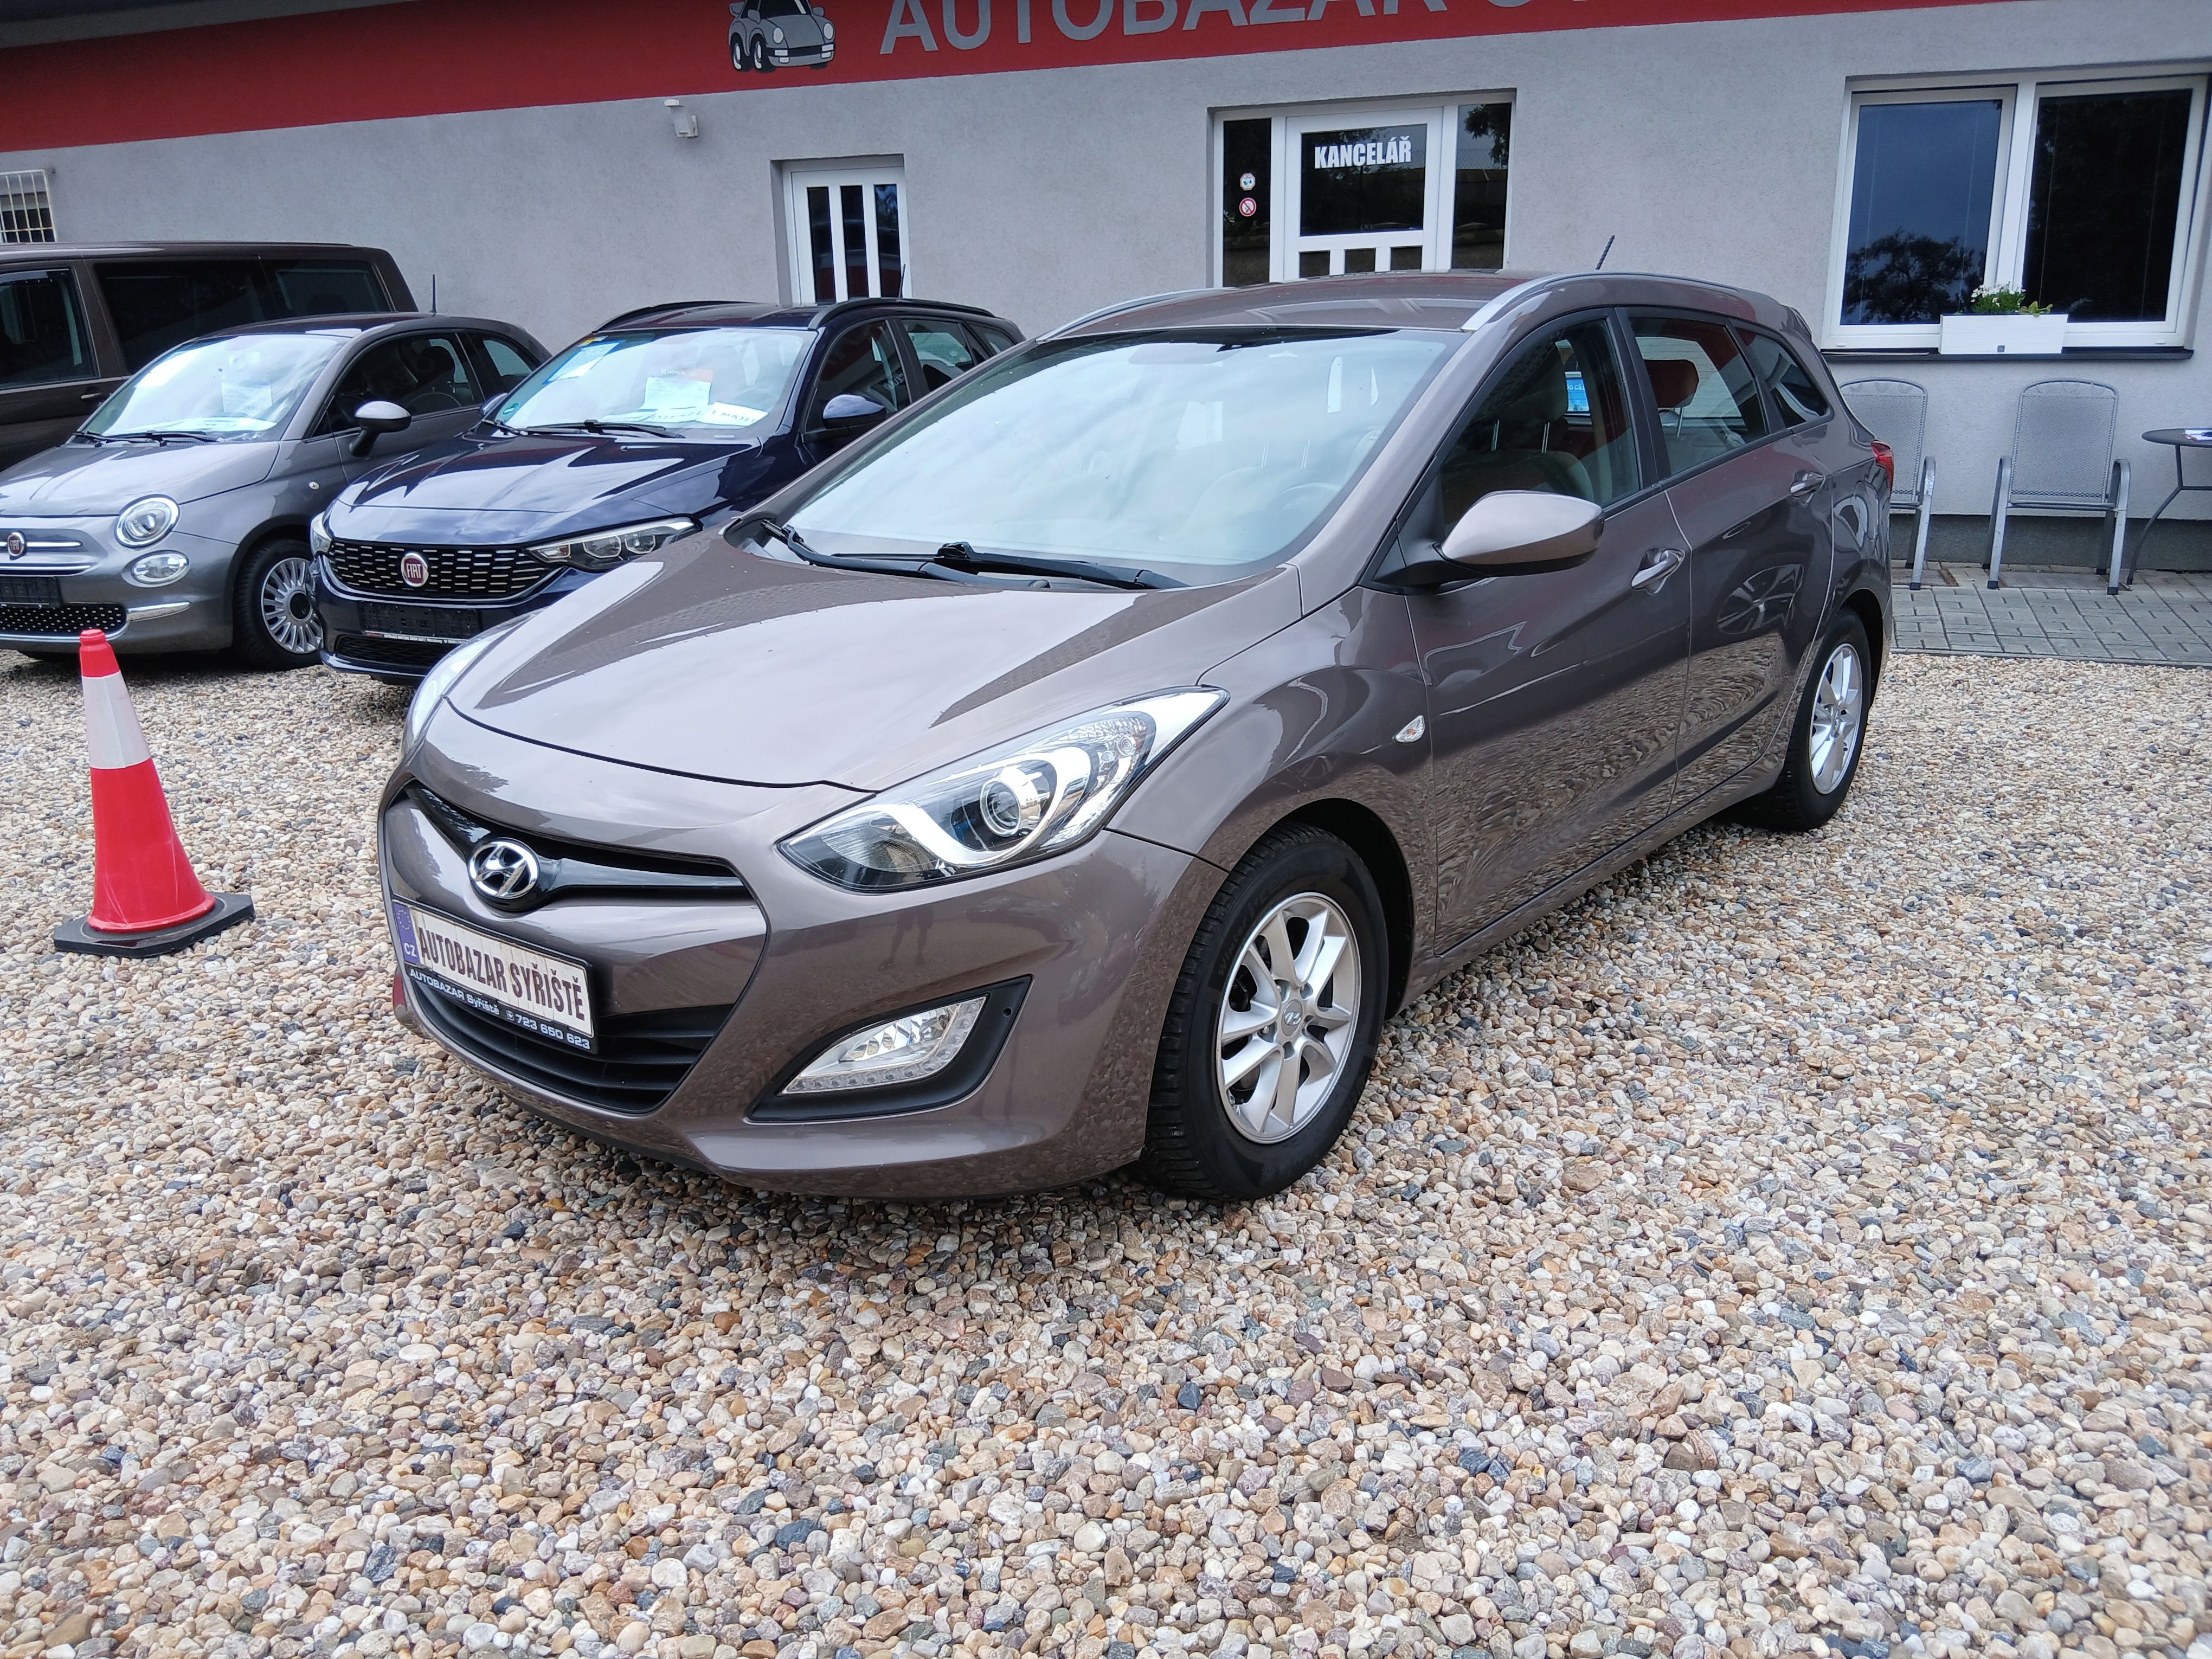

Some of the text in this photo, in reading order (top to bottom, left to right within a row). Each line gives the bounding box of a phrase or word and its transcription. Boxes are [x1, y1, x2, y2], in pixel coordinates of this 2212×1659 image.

[880, 0, 1448, 54] AUTOB
[1314, 136, 1411, 169] KANCELÁŘ
[10, 540, 20, 550] FIAT
[406, 563, 421, 578] FIAT
[404, 942, 417, 957] CZ
[419, 927, 585, 1021] AUTOBAZAR SYŘIŠTĚ
[410, 969, 590, 1050] AUTOBAZAR Syřiště 723 650 623
